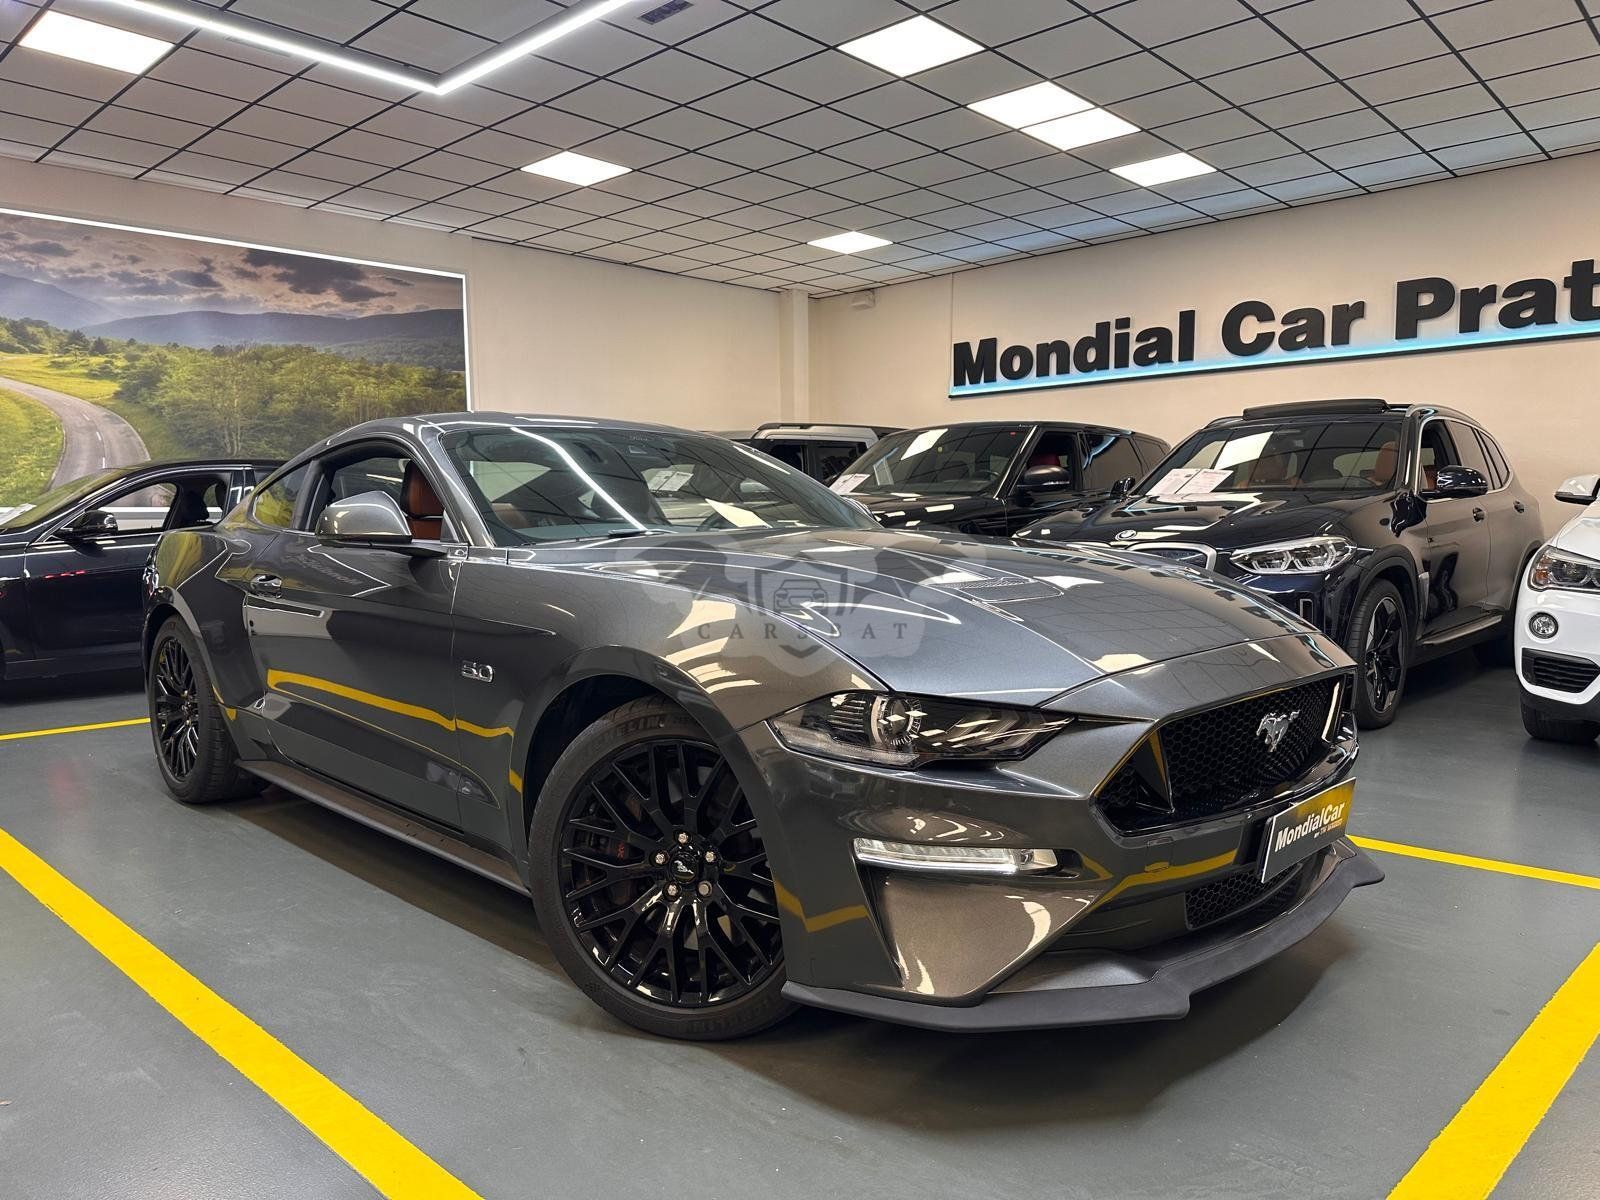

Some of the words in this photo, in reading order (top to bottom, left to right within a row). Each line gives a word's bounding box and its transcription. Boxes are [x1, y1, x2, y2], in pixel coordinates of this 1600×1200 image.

[953, 309, 1196, 387] Mondial
[1221, 299, 1366, 357] Car
[1395, 259, 1600, 340] Prat
[1274, 802, 1345, 852] MondialCar
